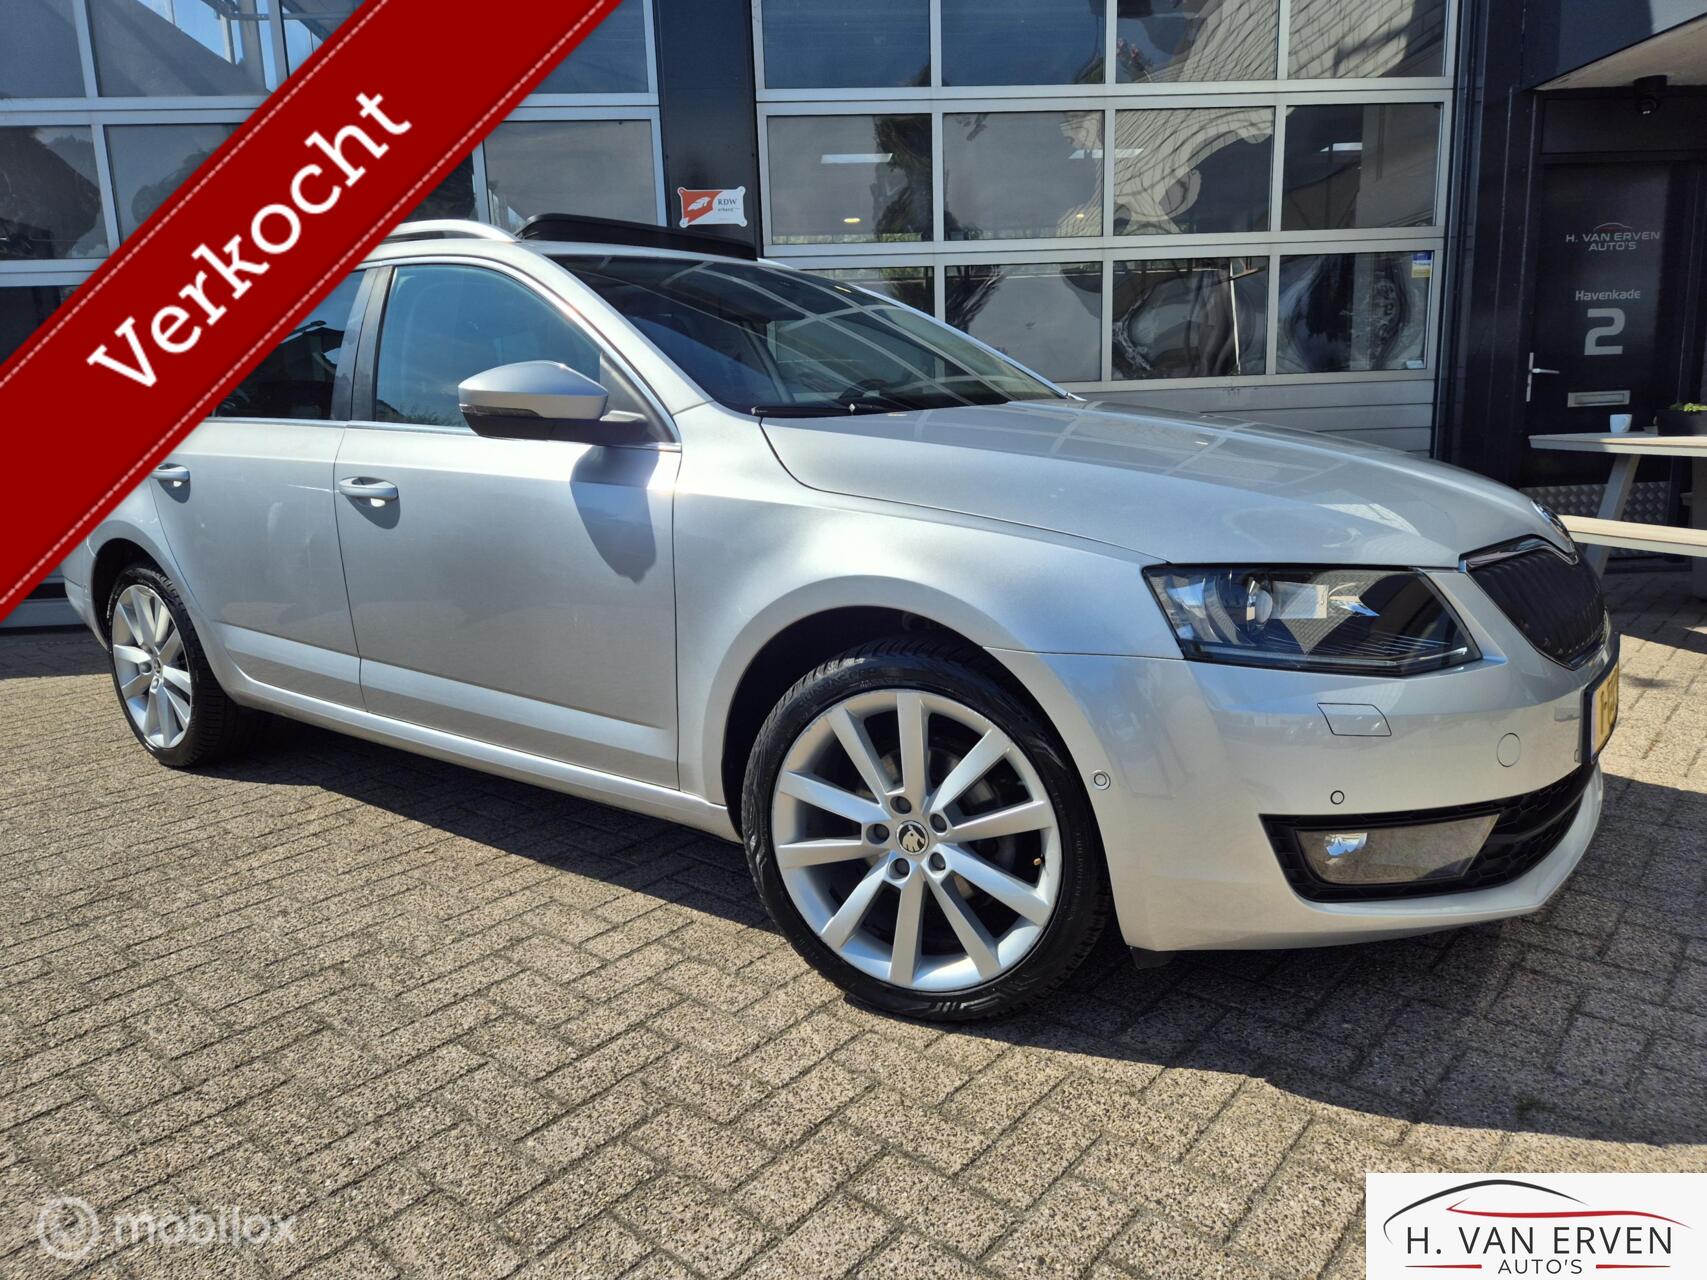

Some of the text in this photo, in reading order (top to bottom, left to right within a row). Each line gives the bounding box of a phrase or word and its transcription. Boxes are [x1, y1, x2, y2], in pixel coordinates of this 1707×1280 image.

[717, 198, 737, 206] RDW
[1566, 231, 1660, 243] H. VAN ERVEN
[1588, 241, 1637, 251] AUTO'S
[1575, 289, 1641, 301] Havenkade
[1584, 307, 1626, 356] 2
